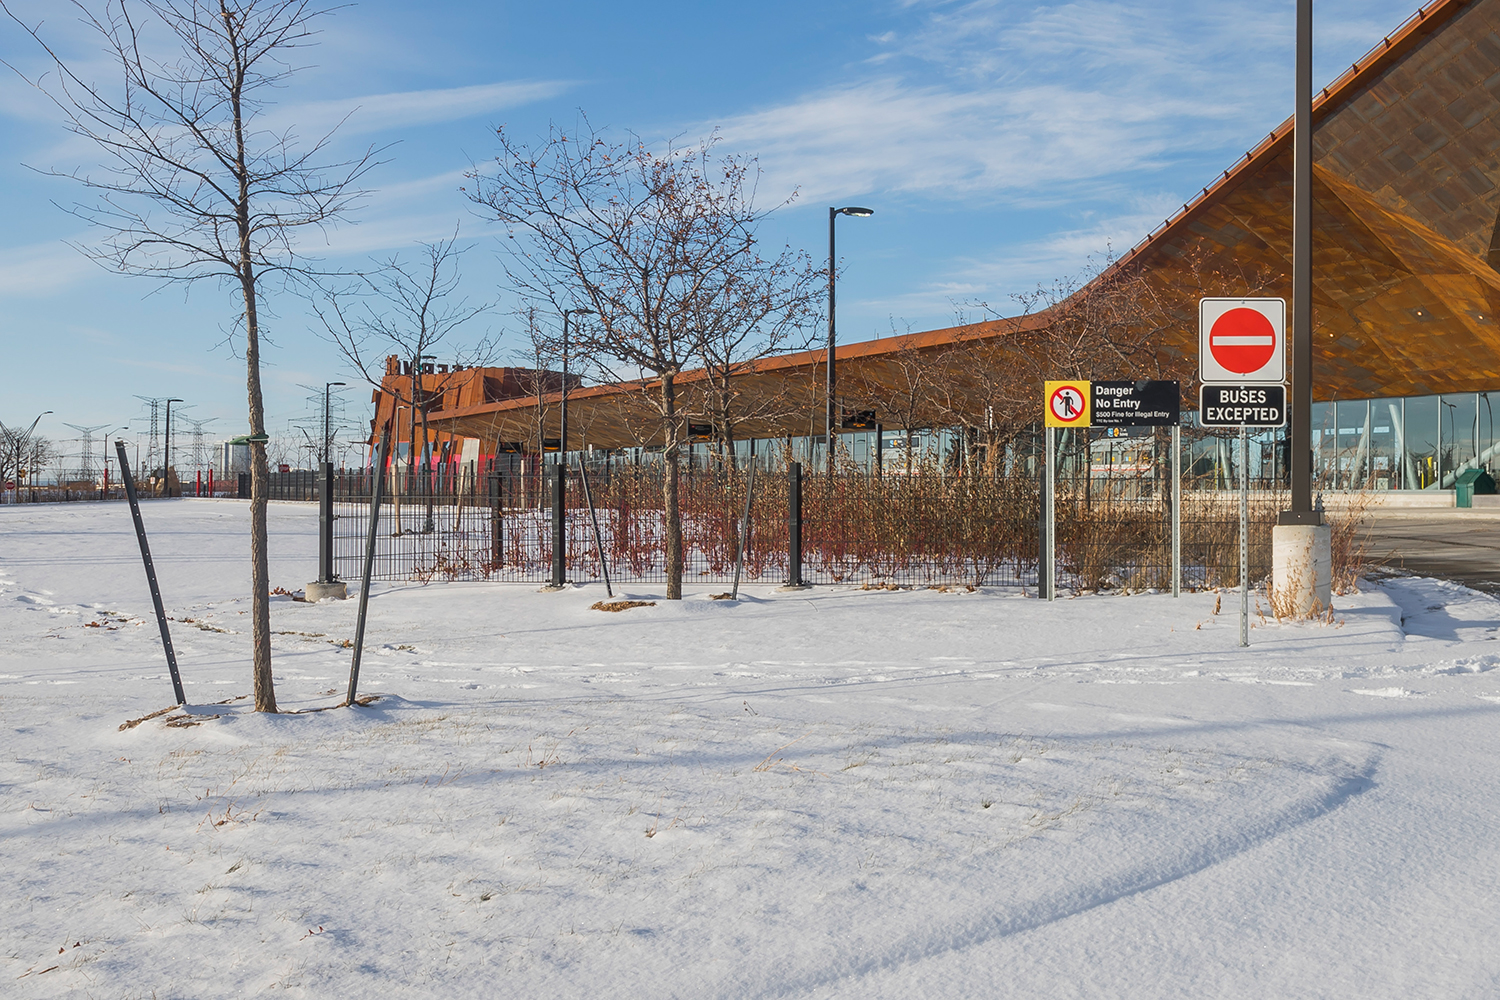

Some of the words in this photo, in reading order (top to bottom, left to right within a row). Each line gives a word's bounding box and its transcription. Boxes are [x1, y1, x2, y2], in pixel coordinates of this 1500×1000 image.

[1095, 385, 1134, 397] Danger
[1219, 390, 1267, 404] BUSES
[1095, 398, 1111, 408] No
[1113, 398, 1141, 410] Entry
[1134, 411, 1153, 419] Illegal
[1153, 411, 1170, 419] Entry
[1206, 407, 1279, 421] EXCEPTED
